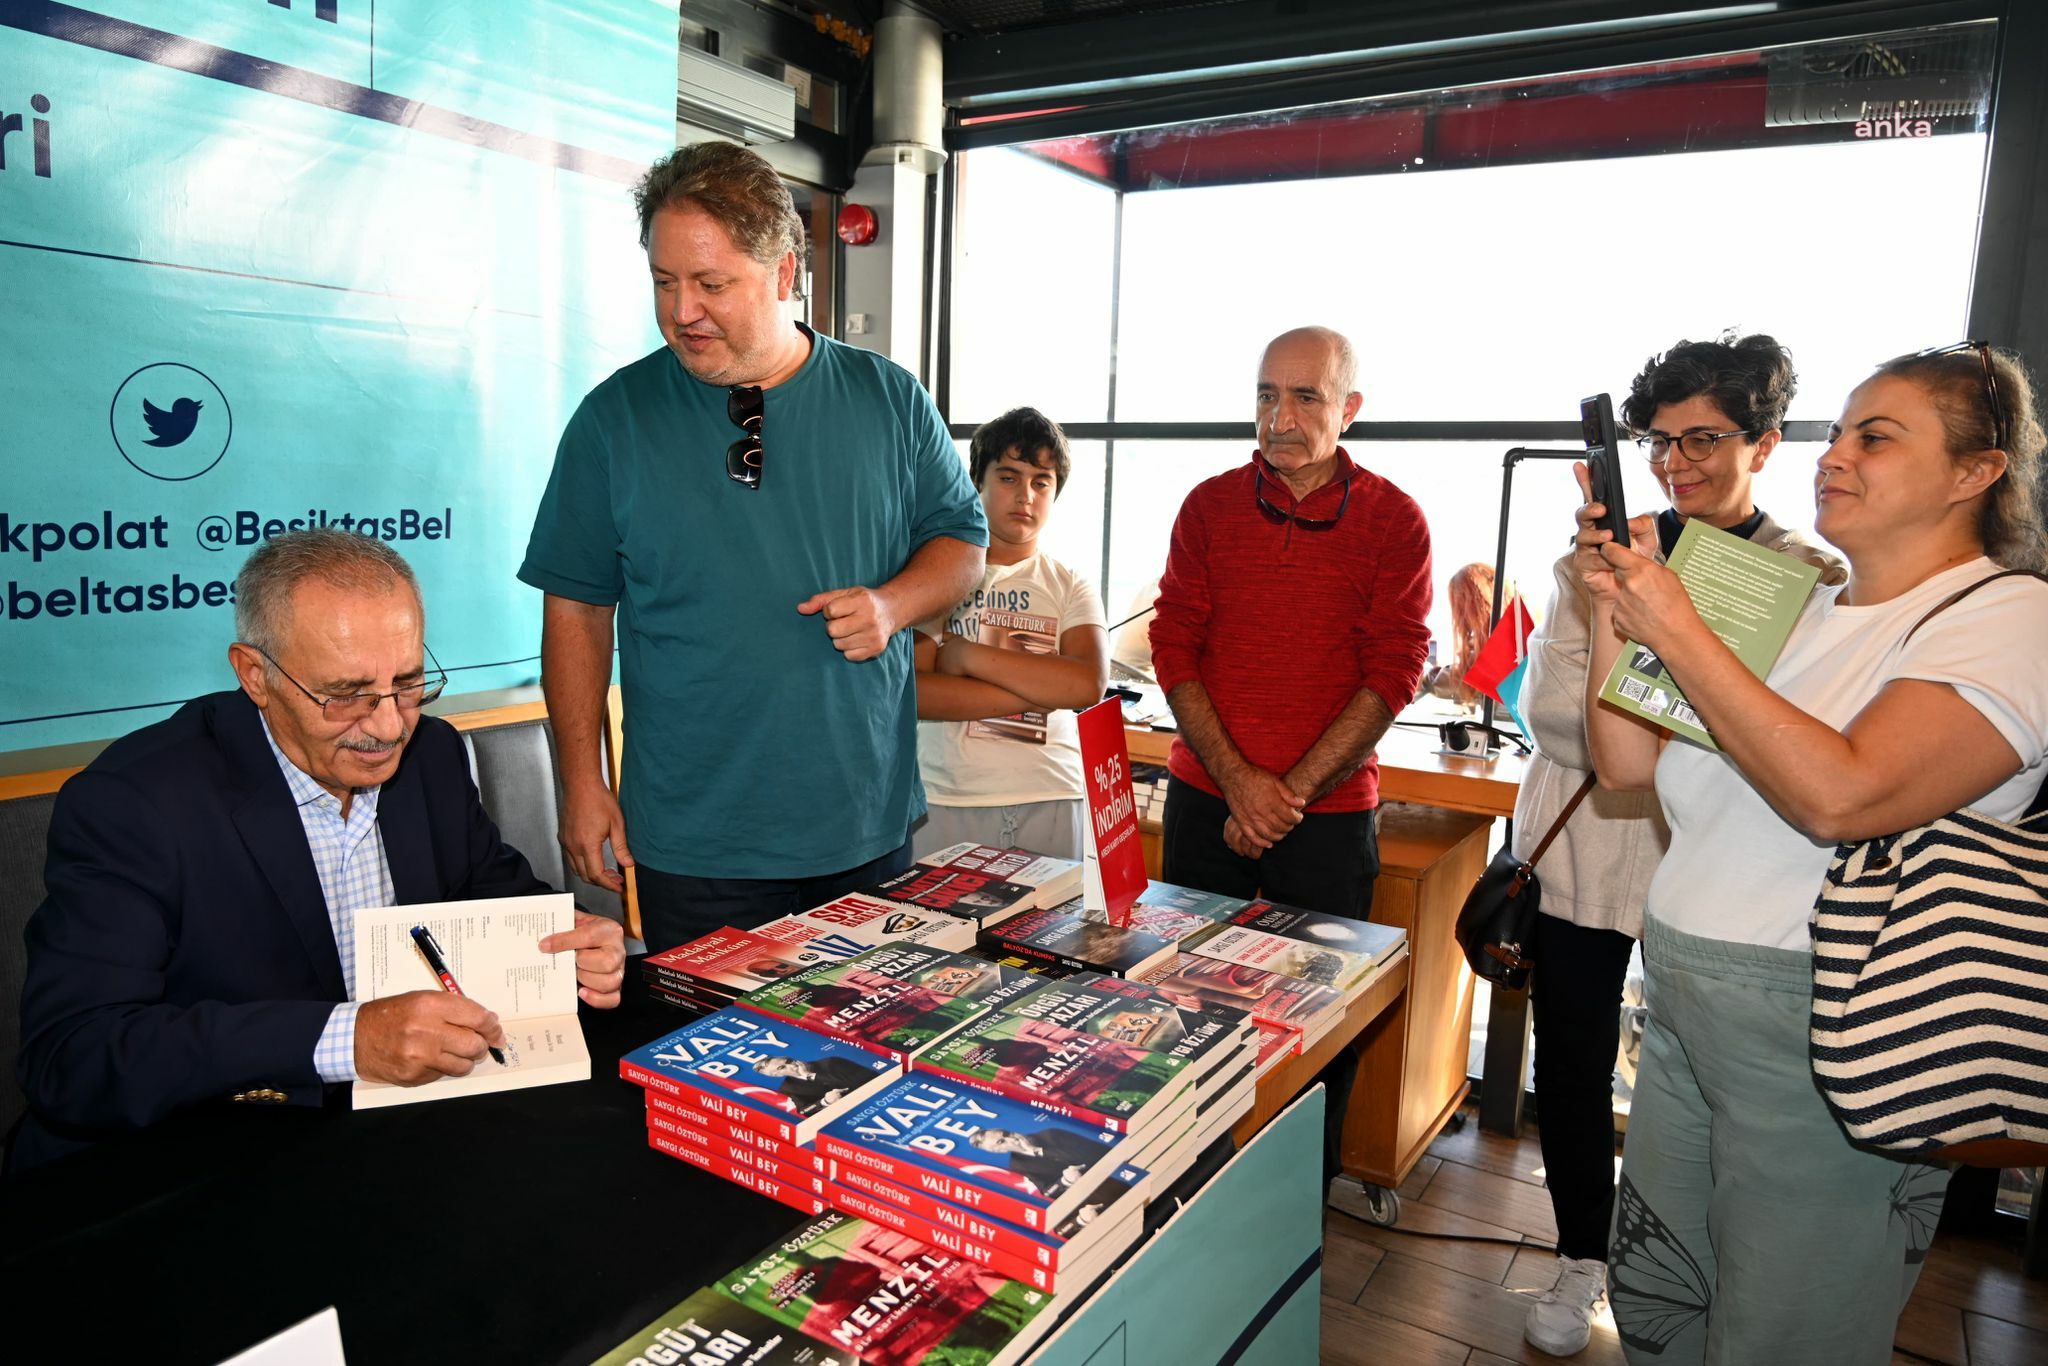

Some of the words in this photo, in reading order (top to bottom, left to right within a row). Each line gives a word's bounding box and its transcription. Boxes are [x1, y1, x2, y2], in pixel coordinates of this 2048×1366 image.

[0, 574, 237, 620] beltasbe
[985, 612, 1010, 628] SAYGI
[1095, 788, 1133, 838] İNDİRİM
[839, 904, 897, 928] BABALAR
[659, 935, 729, 963] Madalyalı
[877, 951, 933, 978] AZARI
[750, 981, 791, 1003] SAYGI
[823, 983, 913, 1029] MENZİL
[1013, 990, 1074, 1018] ÖRGÜT
[648, 1035, 685, 1054] SAYGI
[682, 1014, 728, 1038] ÖZTÜRK
[653, 1017, 760, 1063] VALİ
[697, 1030, 790, 1079] BEY
[929, 1036, 968, 1062] SAYGI
[1168, 1038, 1194, 1060] YGI
[1019, 1036, 1100, 1092] MENZİL
[627, 1068, 649, 1084] SAYGI
[649, 1075, 680, 1096] ÖZTÜRK
[700, 1094, 724, 1114] VALİ
[726, 1104, 748, 1123] BEY
[846, 1105, 879, 1128] SAYGI
[876, 1080, 918, 1109] ÖZTÜRK
[853, 1083, 957, 1137] VALİ
[653, 1097, 676, 1113] SAYGI
[676, 1105, 709, 1127] ÖZTÜRK
[729, 1125, 754, 1145] VALİ
[757, 1136, 780, 1154] BEY
[653, 1117, 676, 1133] SAYGI
[676, 1126, 709, 1146] ÖZTÜRK
[729, 1146, 754, 1165] VALİ
[756, 1156, 779, 1176] BEY
[908, 1098, 998, 1156] BEY
[656, 1137, 678, 1153] SAYGI
[678, 1146, 711, 1168] ÖZTÜRK
[730, 1167, 755, 1187] VALİ
[758, 1178, 780, 1197] BEY
[826, 1142, 853, 1161] SAYGI
[854, 1152, 895, 1175] ÖZTÜRK
[920, 1173, 951, 1196] VALİ
[954, 1185, 983, 1207] BEY
[840, 1193, 867, 1212] SAYGI
[866, 1203, 906, 1229] ÖZTÜRK
[930, 1228, 961, 1252] VALİ
[964, 1242, 992, 1264] BEY
[845, 1170, 872, 1189] SAYGI
[872, 1181, 911, 1207] ÖZTÜRK
[935, 1206, 966, 1230] VALİ
[968, 1219, 997, 1243] BEY
[730, 1252, 786, 1296] SAYGI
[780, 1213, 844, 1253] ÖZTÜRK
[830, 1253, 950, 1346] MENZİL
